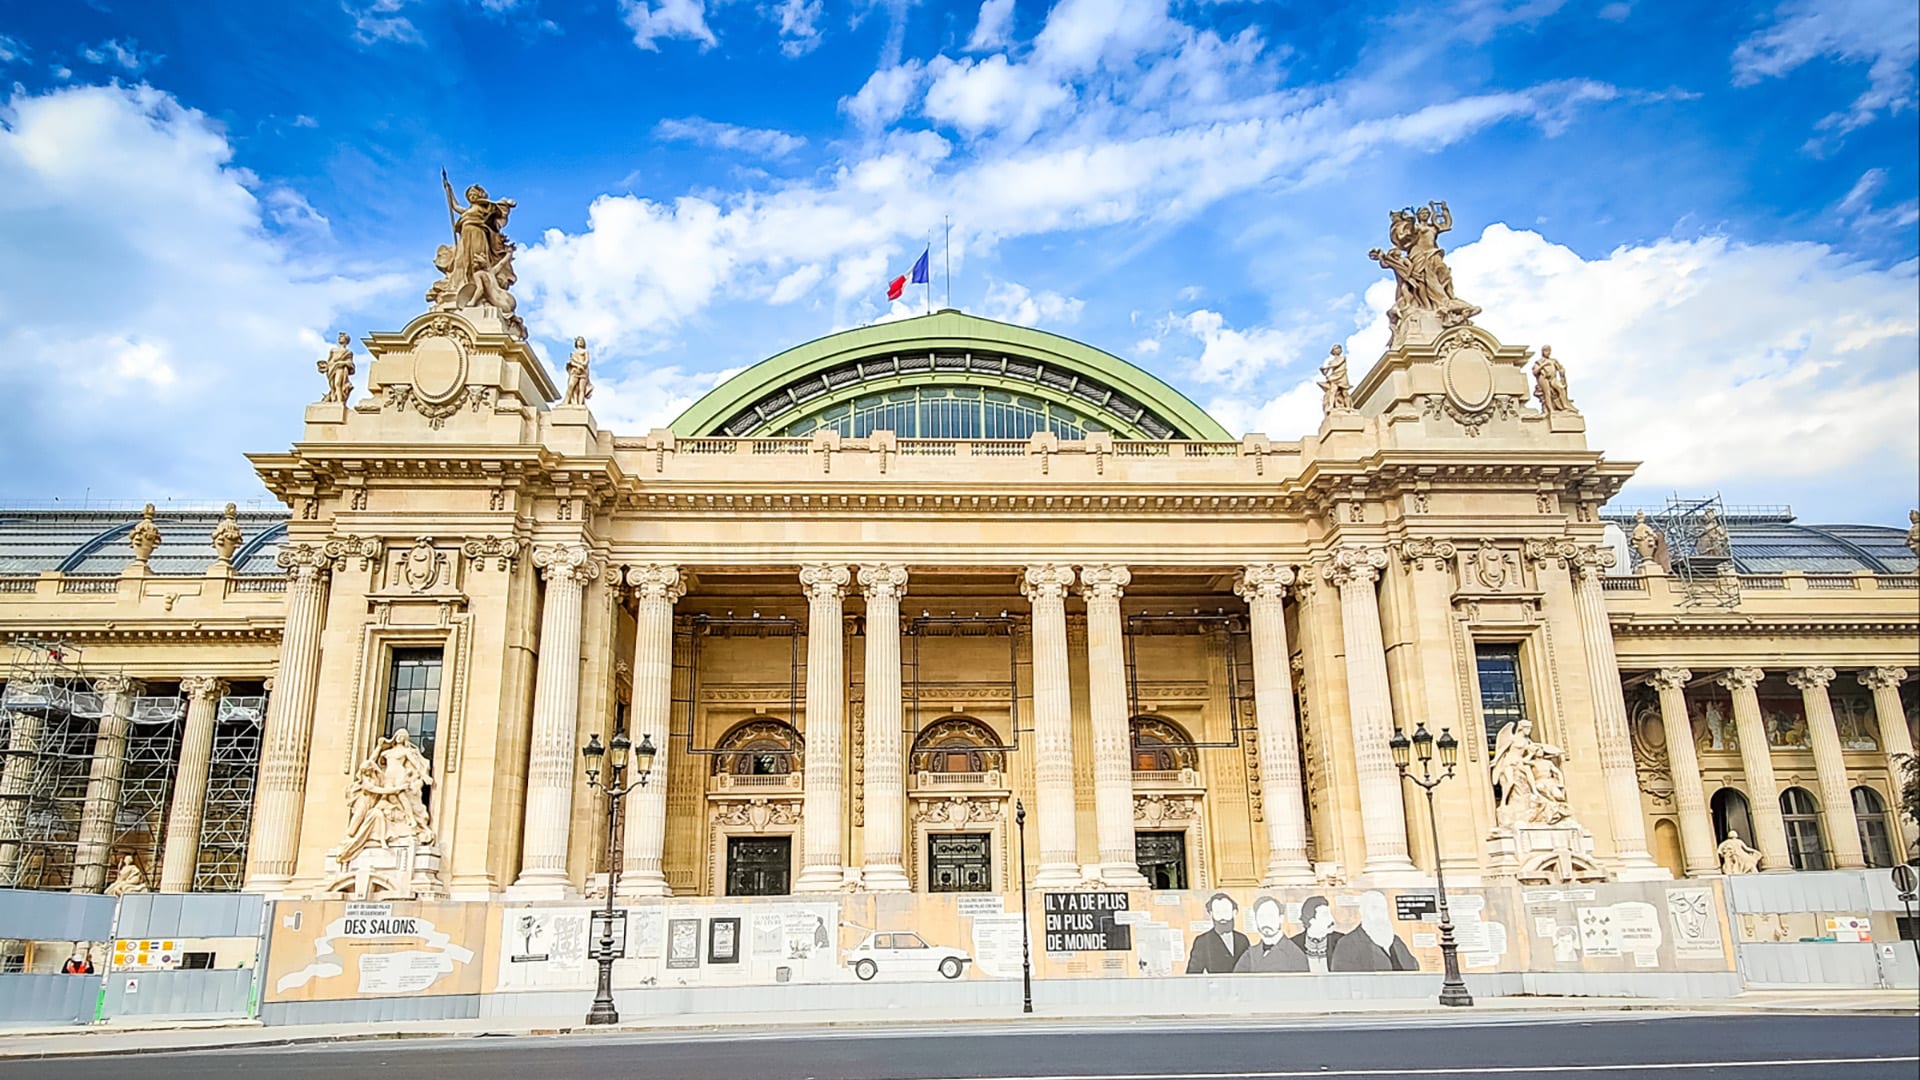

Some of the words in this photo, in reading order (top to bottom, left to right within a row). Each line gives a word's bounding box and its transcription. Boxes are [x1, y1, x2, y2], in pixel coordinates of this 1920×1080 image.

[1046, 895, 1056, 911] IL
[1058, 894, 1066, 910] Y
[1069, 894, 1078, 910] A
[1080, 894, 1096, 910] DE
[1097, 893, 1127, 910] PLUS
[344, 919, 367, 935] DES
[369, 919, 418, 934] SALONS.
[1046, 914, 1062, 931] EN
[1064, 913, 1093, 930] PLUS
[1047, 934, 1063, 950] DE
[1064, 933, 1107, 950] MONDE
